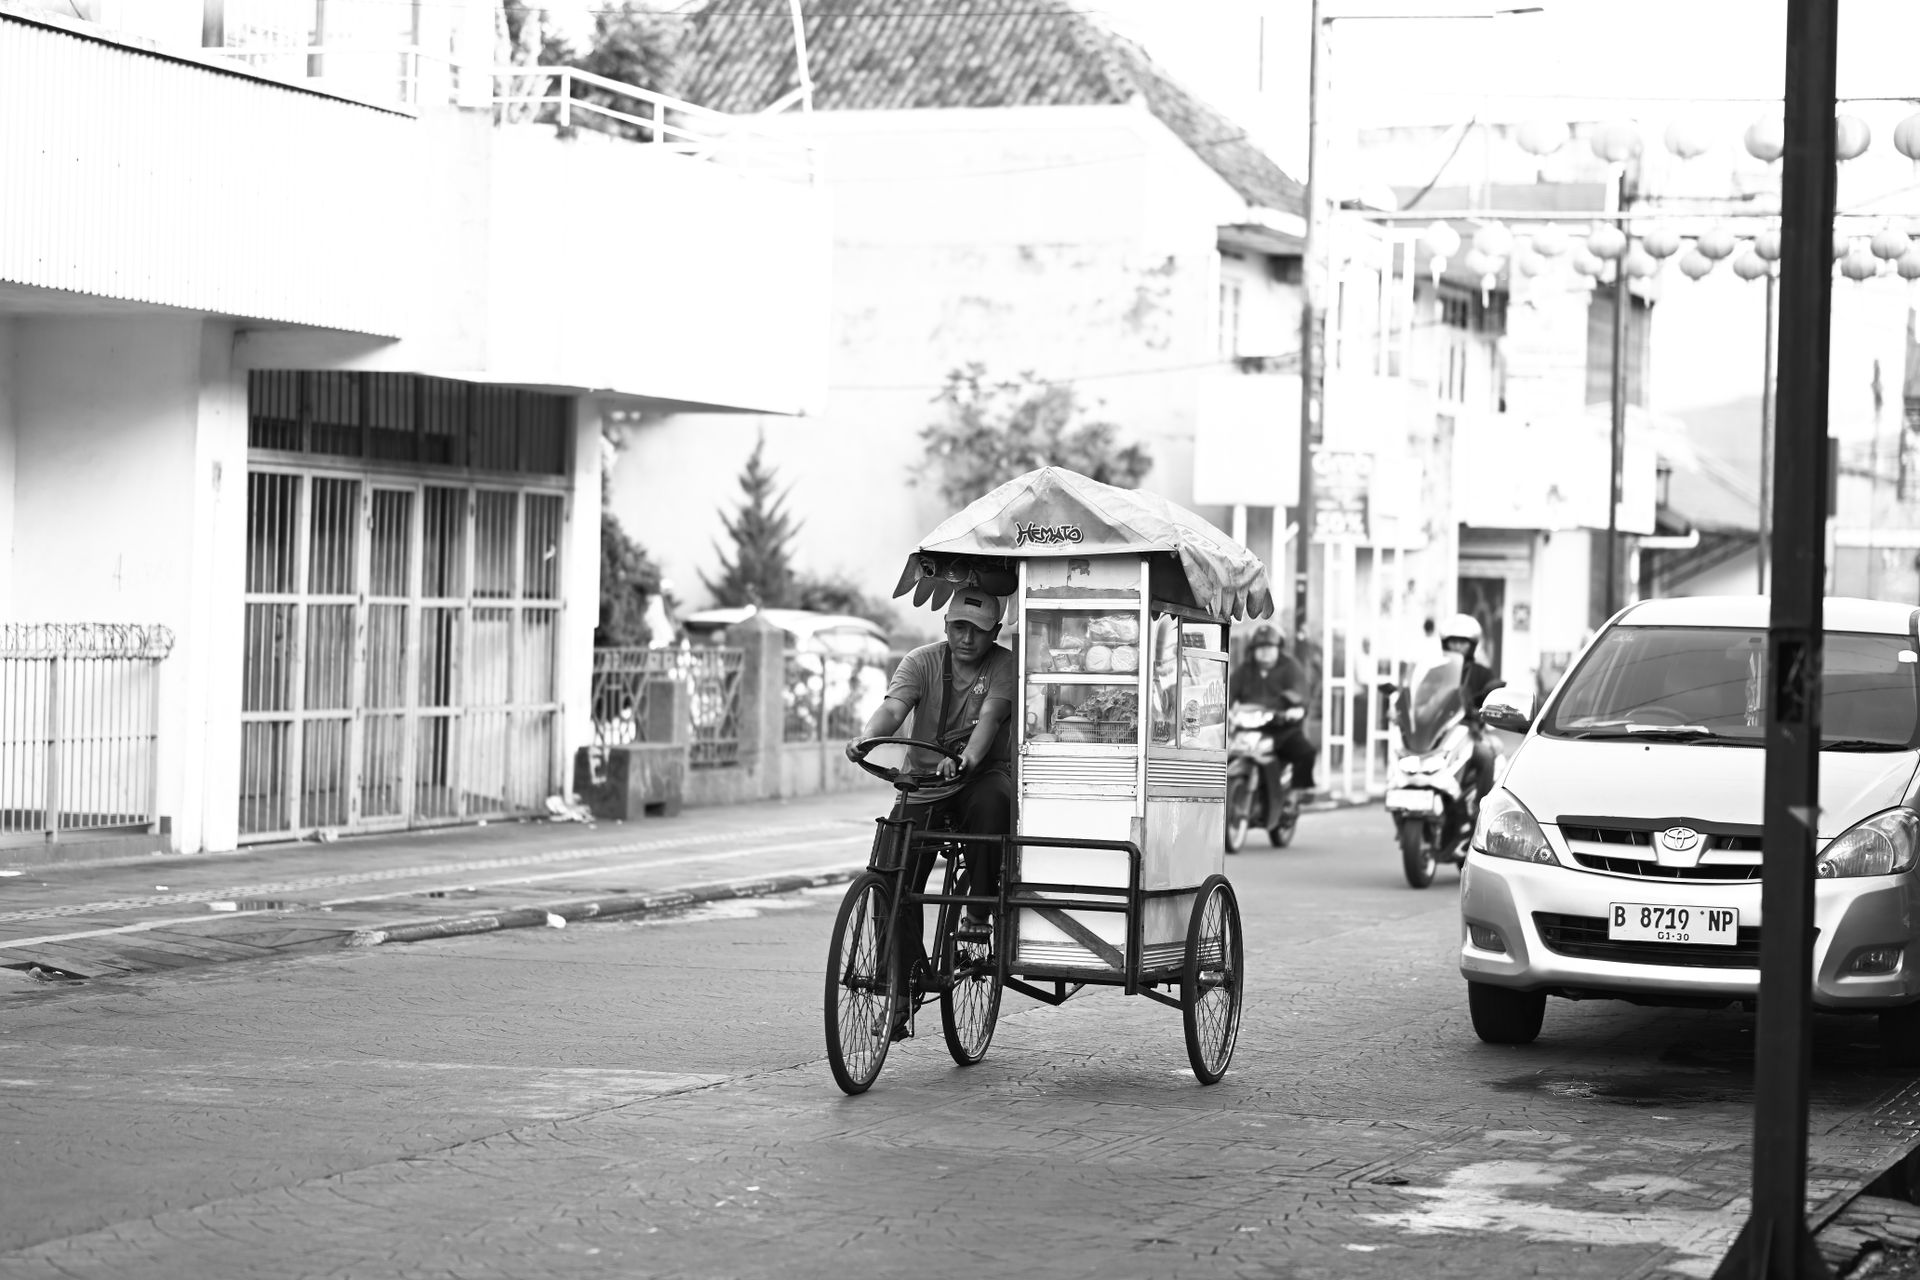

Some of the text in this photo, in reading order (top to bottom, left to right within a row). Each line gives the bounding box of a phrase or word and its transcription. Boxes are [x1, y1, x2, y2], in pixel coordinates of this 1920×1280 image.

[1015, 521, 1083, 547] HEMATO
[1614, 905, 1733, 932] B 8719 NP
